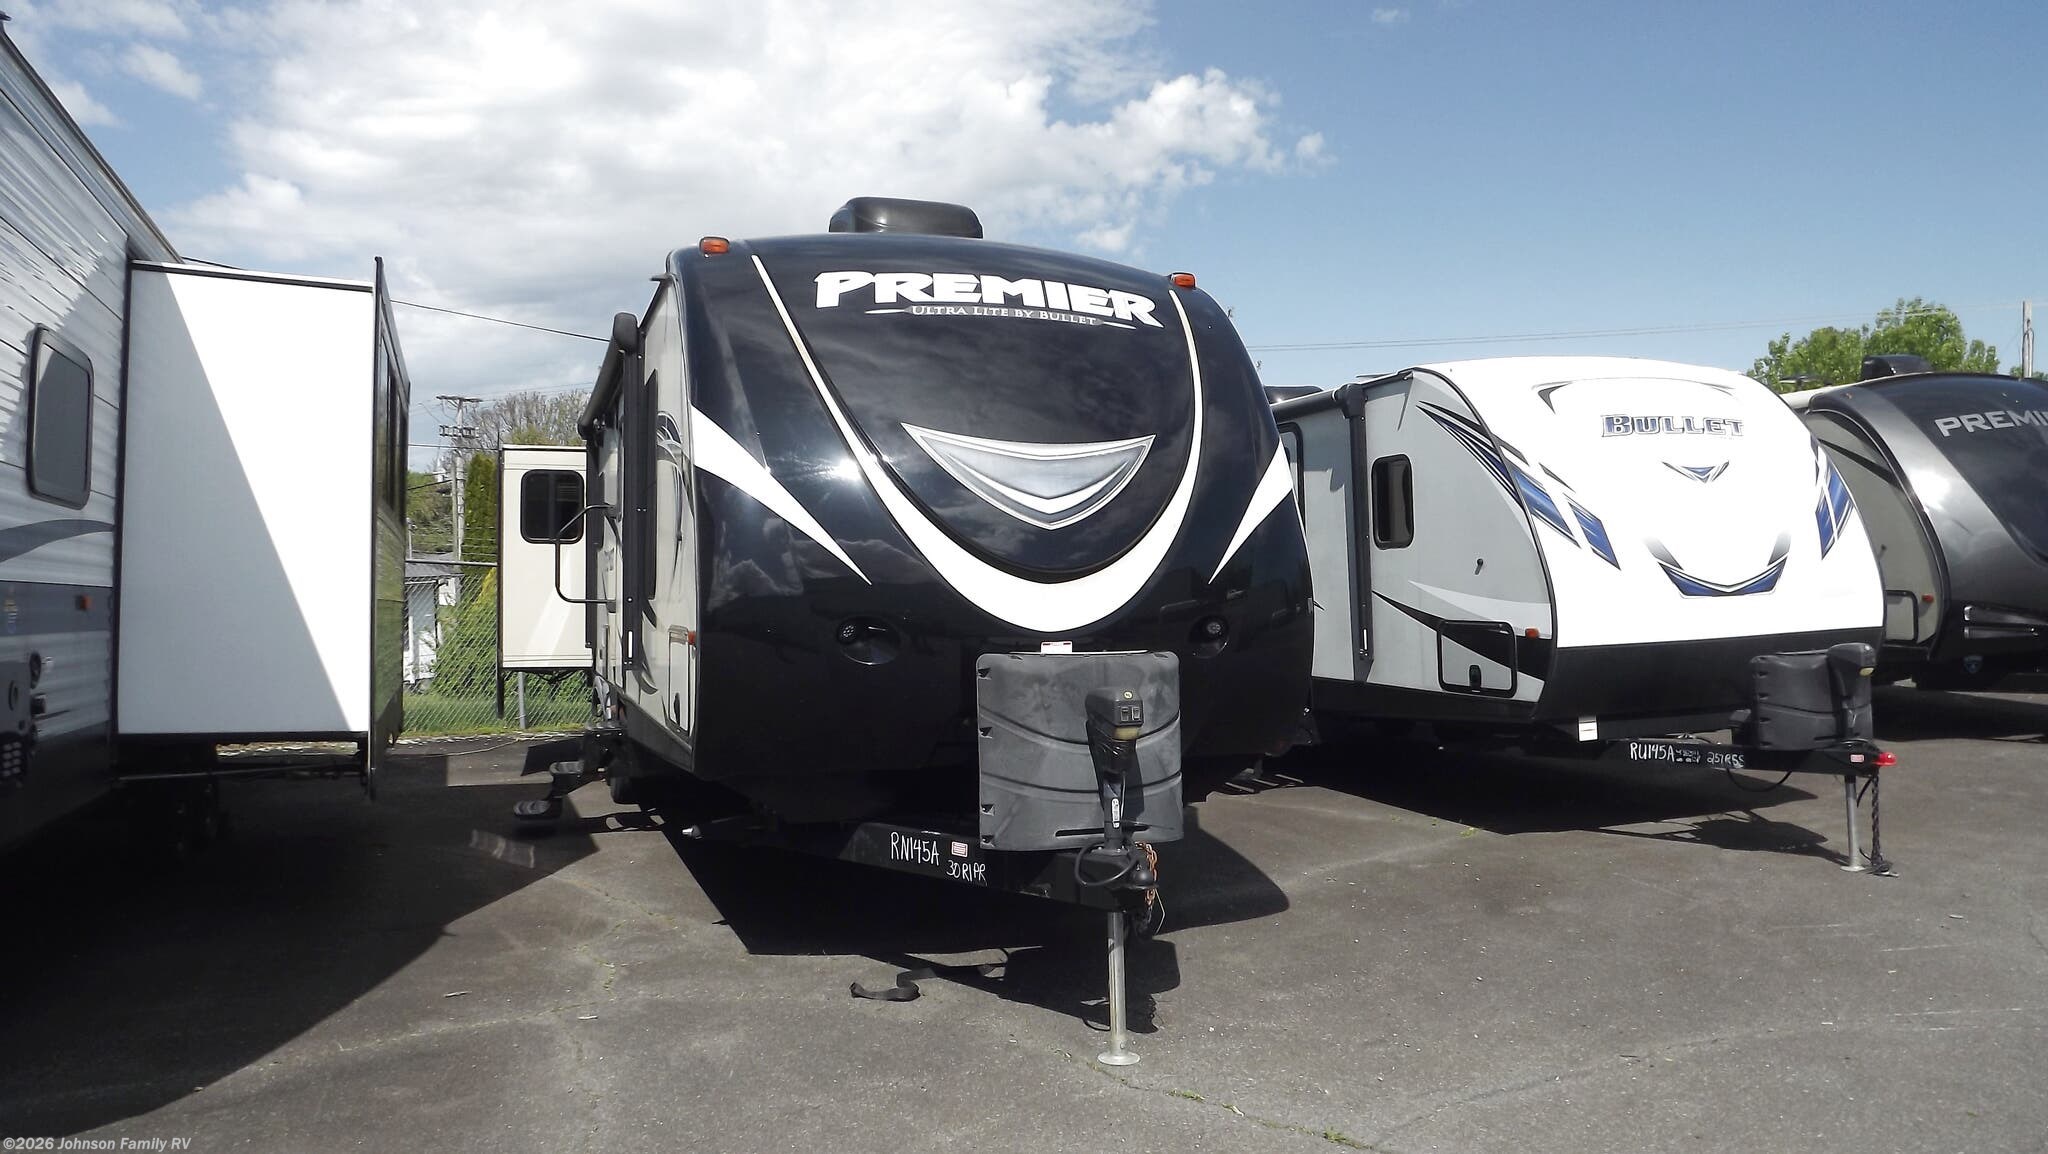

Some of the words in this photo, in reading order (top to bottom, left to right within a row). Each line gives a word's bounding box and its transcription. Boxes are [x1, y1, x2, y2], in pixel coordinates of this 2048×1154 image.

[813, 271, 1165, 329] PREMIER
[911, 305, 968, 316] ULTRA
[973, 306, 1009, 317] LITE
[1015, 308, 1034, 319] BY
[1039, 311, 1097, 326] BULLET
[1600, 413, 1744, 438] BULLET
[1934, 410, 2048, 437] PREMI
[890, 831, 940, 866] RN145A
